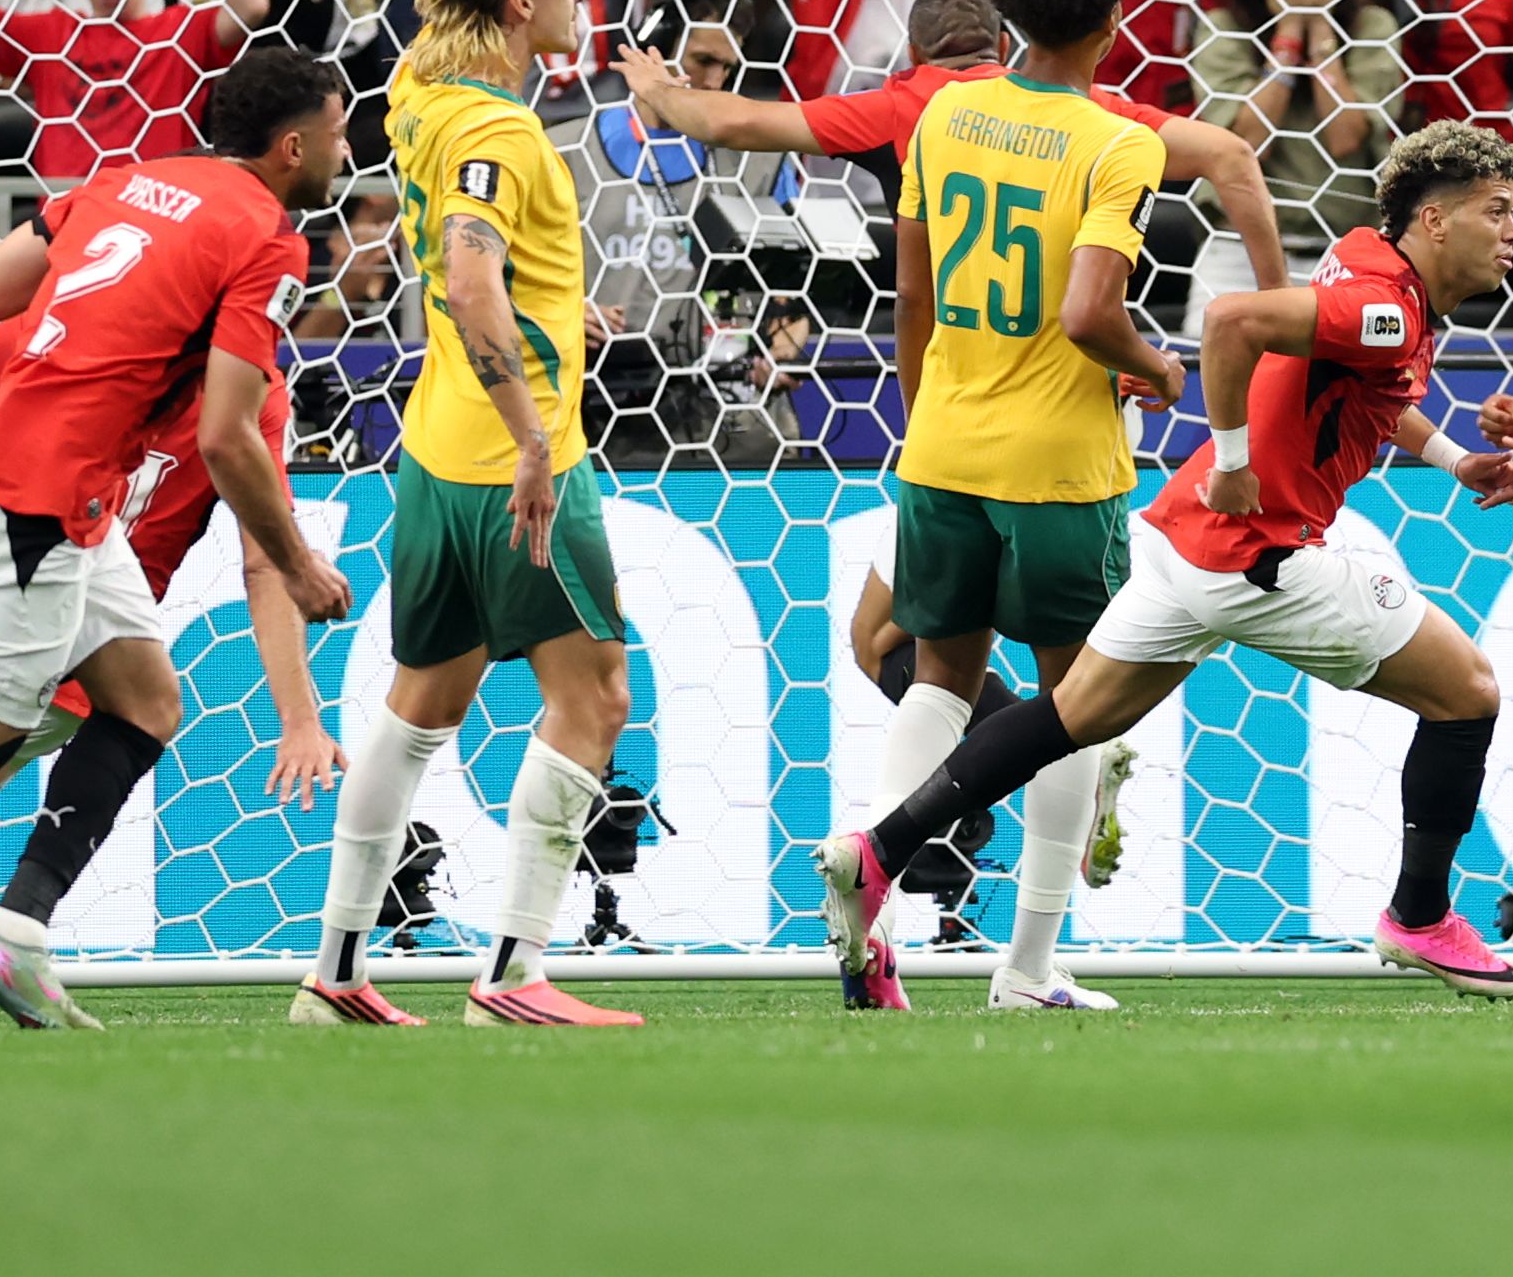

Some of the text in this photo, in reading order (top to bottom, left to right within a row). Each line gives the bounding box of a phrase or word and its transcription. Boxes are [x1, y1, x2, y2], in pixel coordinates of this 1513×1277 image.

[945, 106, 1071, 162] HERRINGTON
[117, 173, 202, 223] YASSER
[23, 222, 153, 360] 2
[936, 172, 1046, 337] 25
